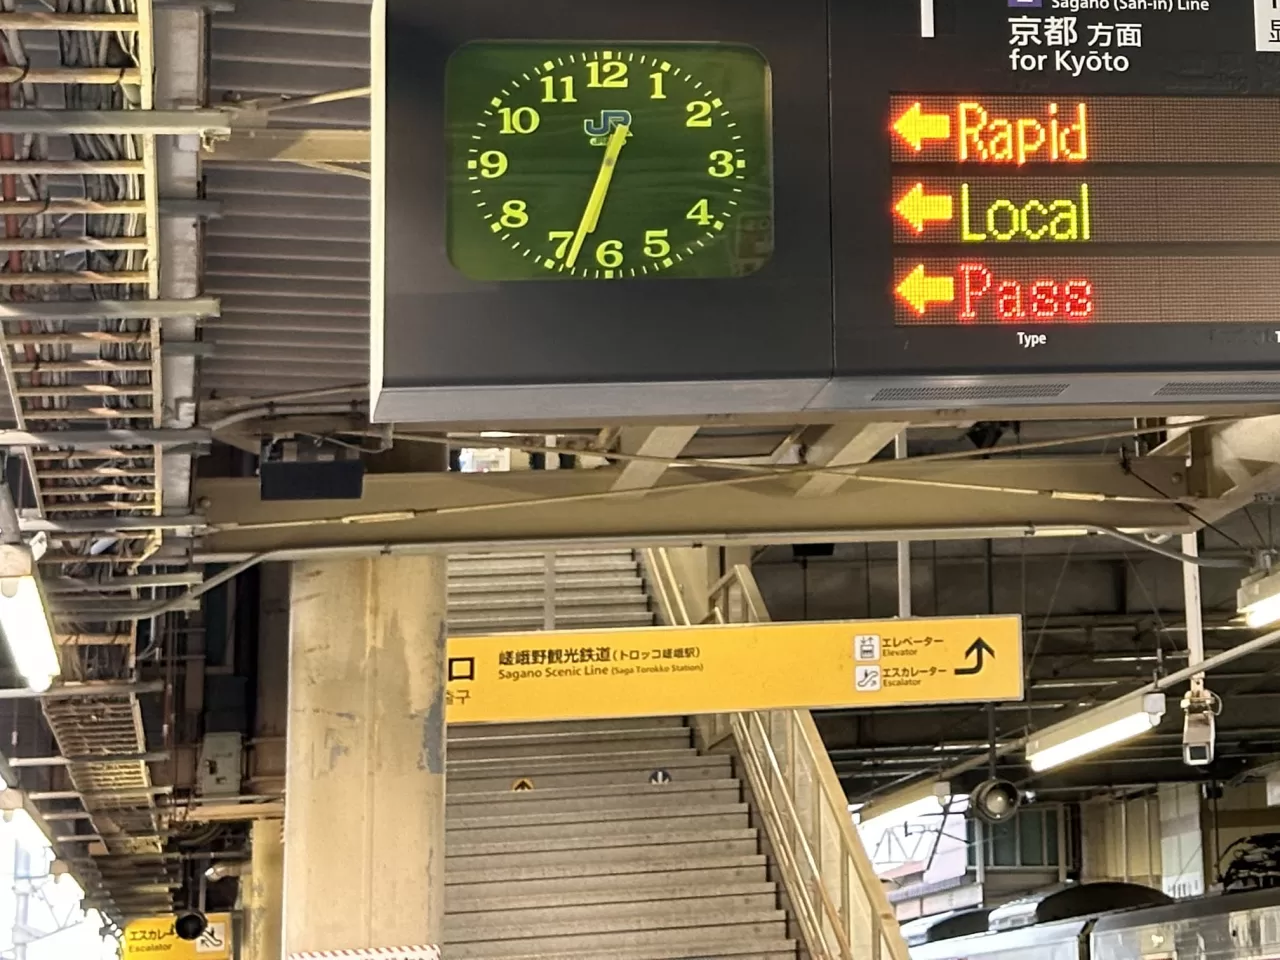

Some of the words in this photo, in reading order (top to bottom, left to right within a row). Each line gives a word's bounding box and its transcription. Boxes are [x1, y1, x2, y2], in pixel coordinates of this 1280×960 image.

[1007, 15, 1079, 47] 京都
[1086, 22, 1143, 48] 方面
[585, 61, 629, 88] 12
[1008, 47, 1048, 71] for
[1055, 50, 1130, 77] Kyōto
[541, 75, 578, 103] 11
[650, 72, 667, 99] 1
[498, 106, 540, 134] 10
[686, 101, 712, 128] 2
[956, 101, 1090, 166] Rapid
[480, 150, 508, 179] 9
[708, 150, 734, 178] 3
[500, 199, 529, 229] 8
[686, 198, 713, 226] 4
[958, 182, 1092, 242] Local
[548, 230, 575, 260] 7
[596, 240, 624, 268] 6
[643, 228, 671, 258] 5
[959, 262, 1095, 321] Pass
[1016, 331, 1047, 348] Type
[882, 636, 944, 648] エレベーター
[882, 649, 918, 657] Elevator
[498, 668, 542, 681] Sagano
[545, 665, 582, 678] Scenic
[584, 664, 609, 676] Line
[882, 666, 947, 678] エスカレーター
[883, 678, 922, 687] Escalator
[129, 943, 173, 953] Escalator
